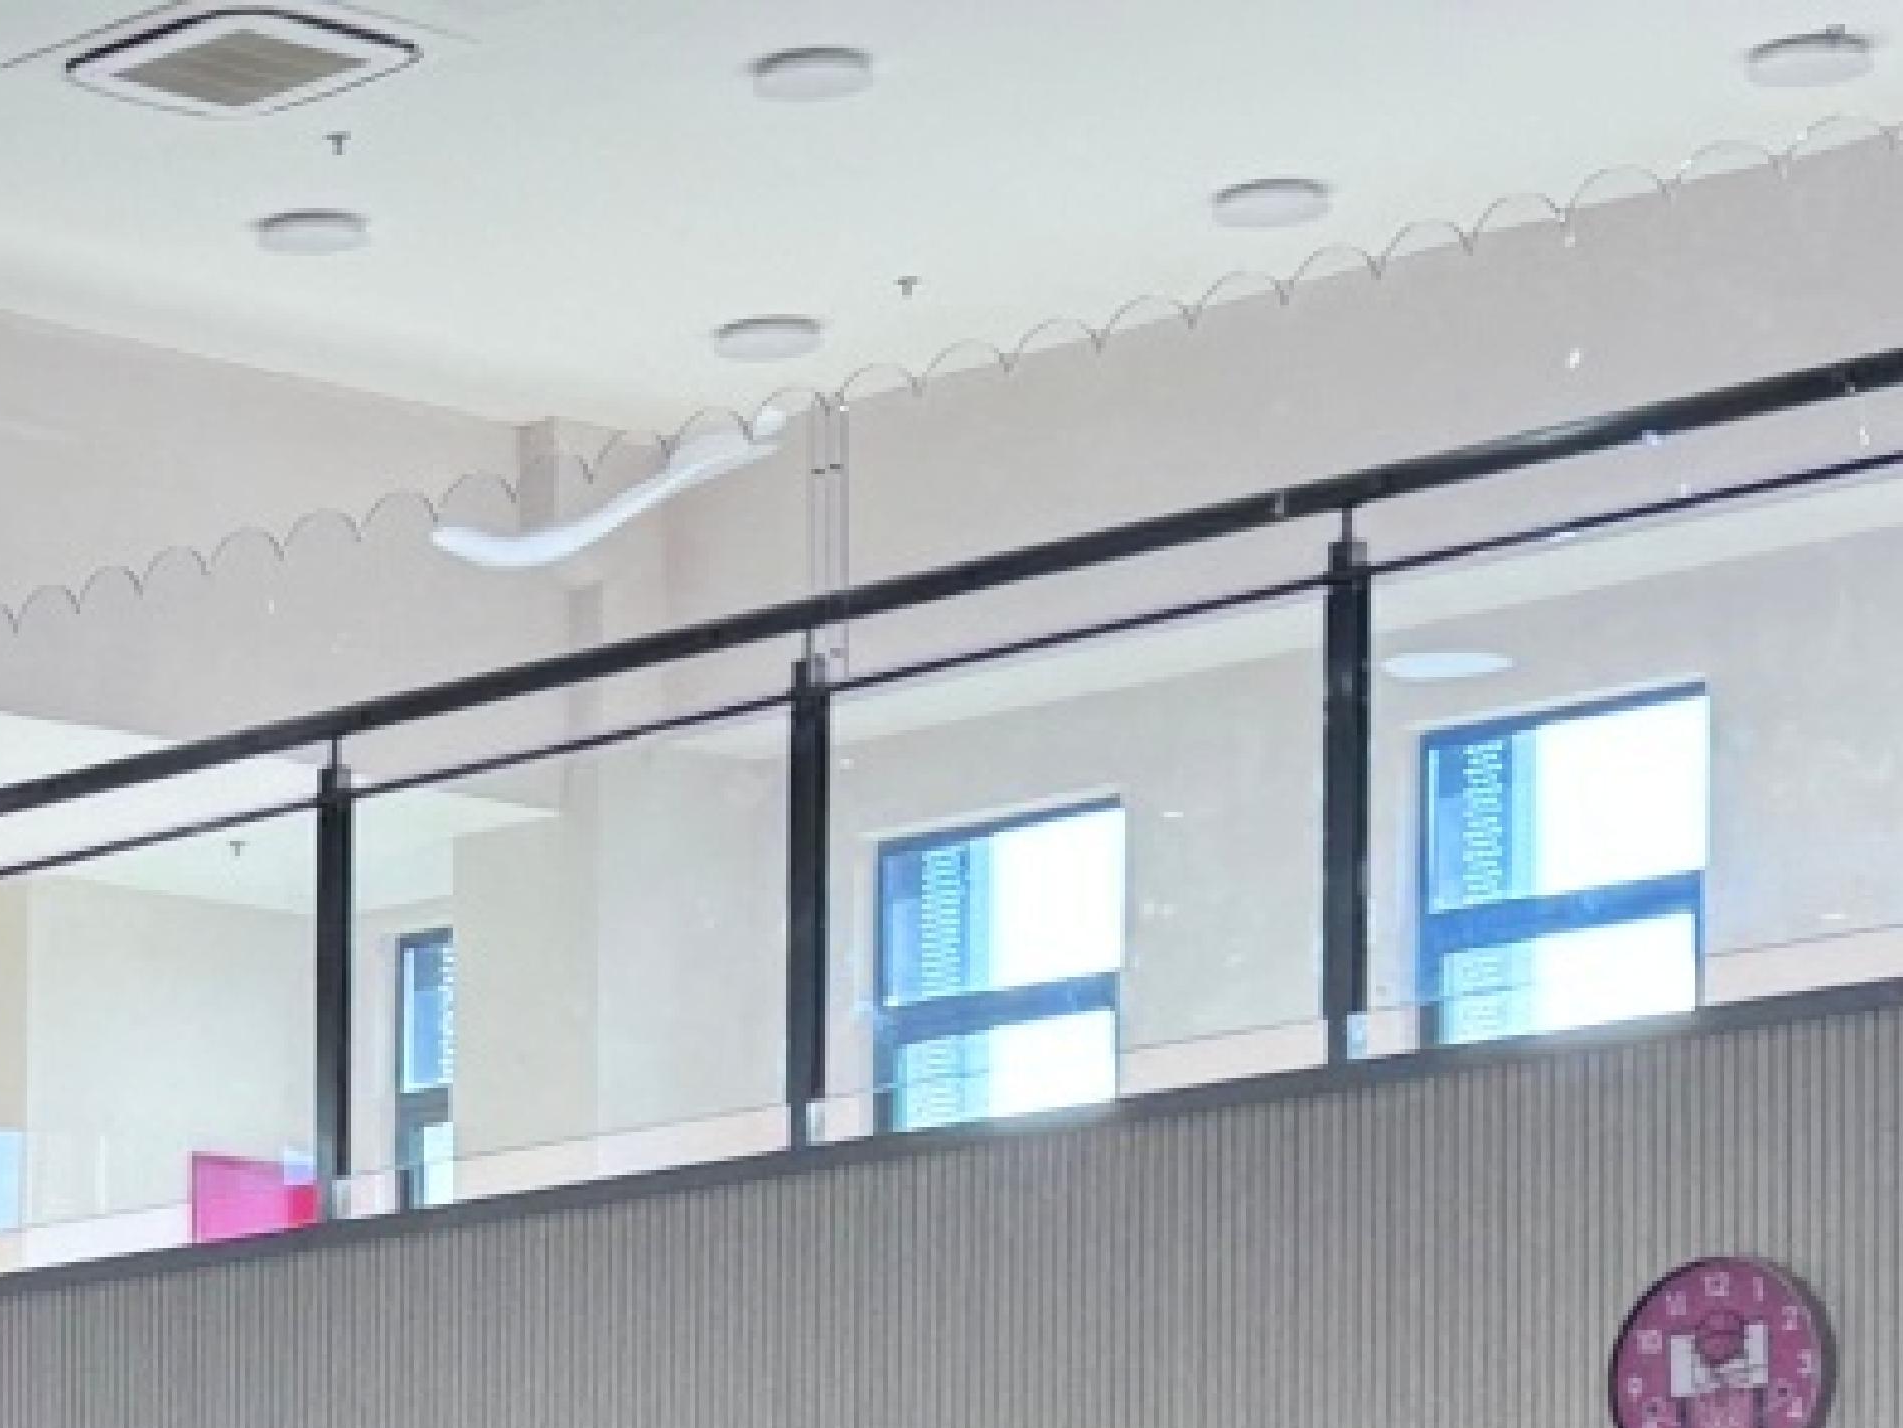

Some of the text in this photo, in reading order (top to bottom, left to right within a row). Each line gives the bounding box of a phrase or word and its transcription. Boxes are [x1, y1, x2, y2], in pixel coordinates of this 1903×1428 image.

[1704, 1271, 1730, 1297] 12
[1781, 1305, 1801, 1332] 2
[1636, 1328, 1664, 1355] 10
[1796, 1348, 1814, 1376] 3
